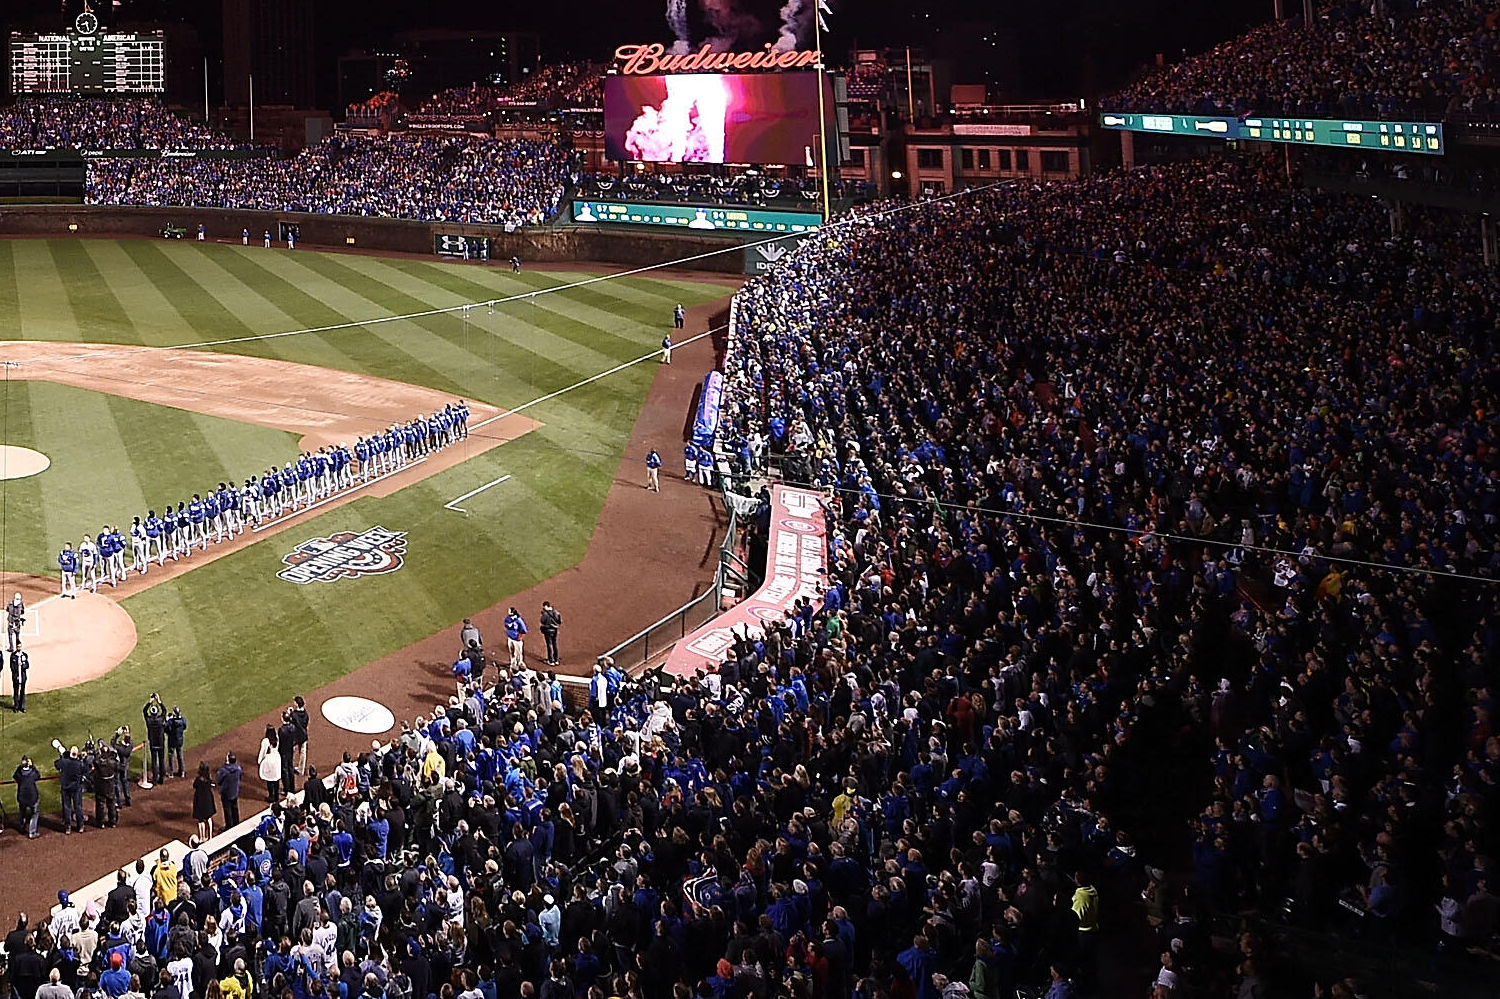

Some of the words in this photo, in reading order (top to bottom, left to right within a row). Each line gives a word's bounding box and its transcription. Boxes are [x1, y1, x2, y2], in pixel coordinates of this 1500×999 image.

[615, 42, 821, 74] Budweiser
[280, 546, 362, 582] OPENING
[343, 527, 396, 550] WEEK
